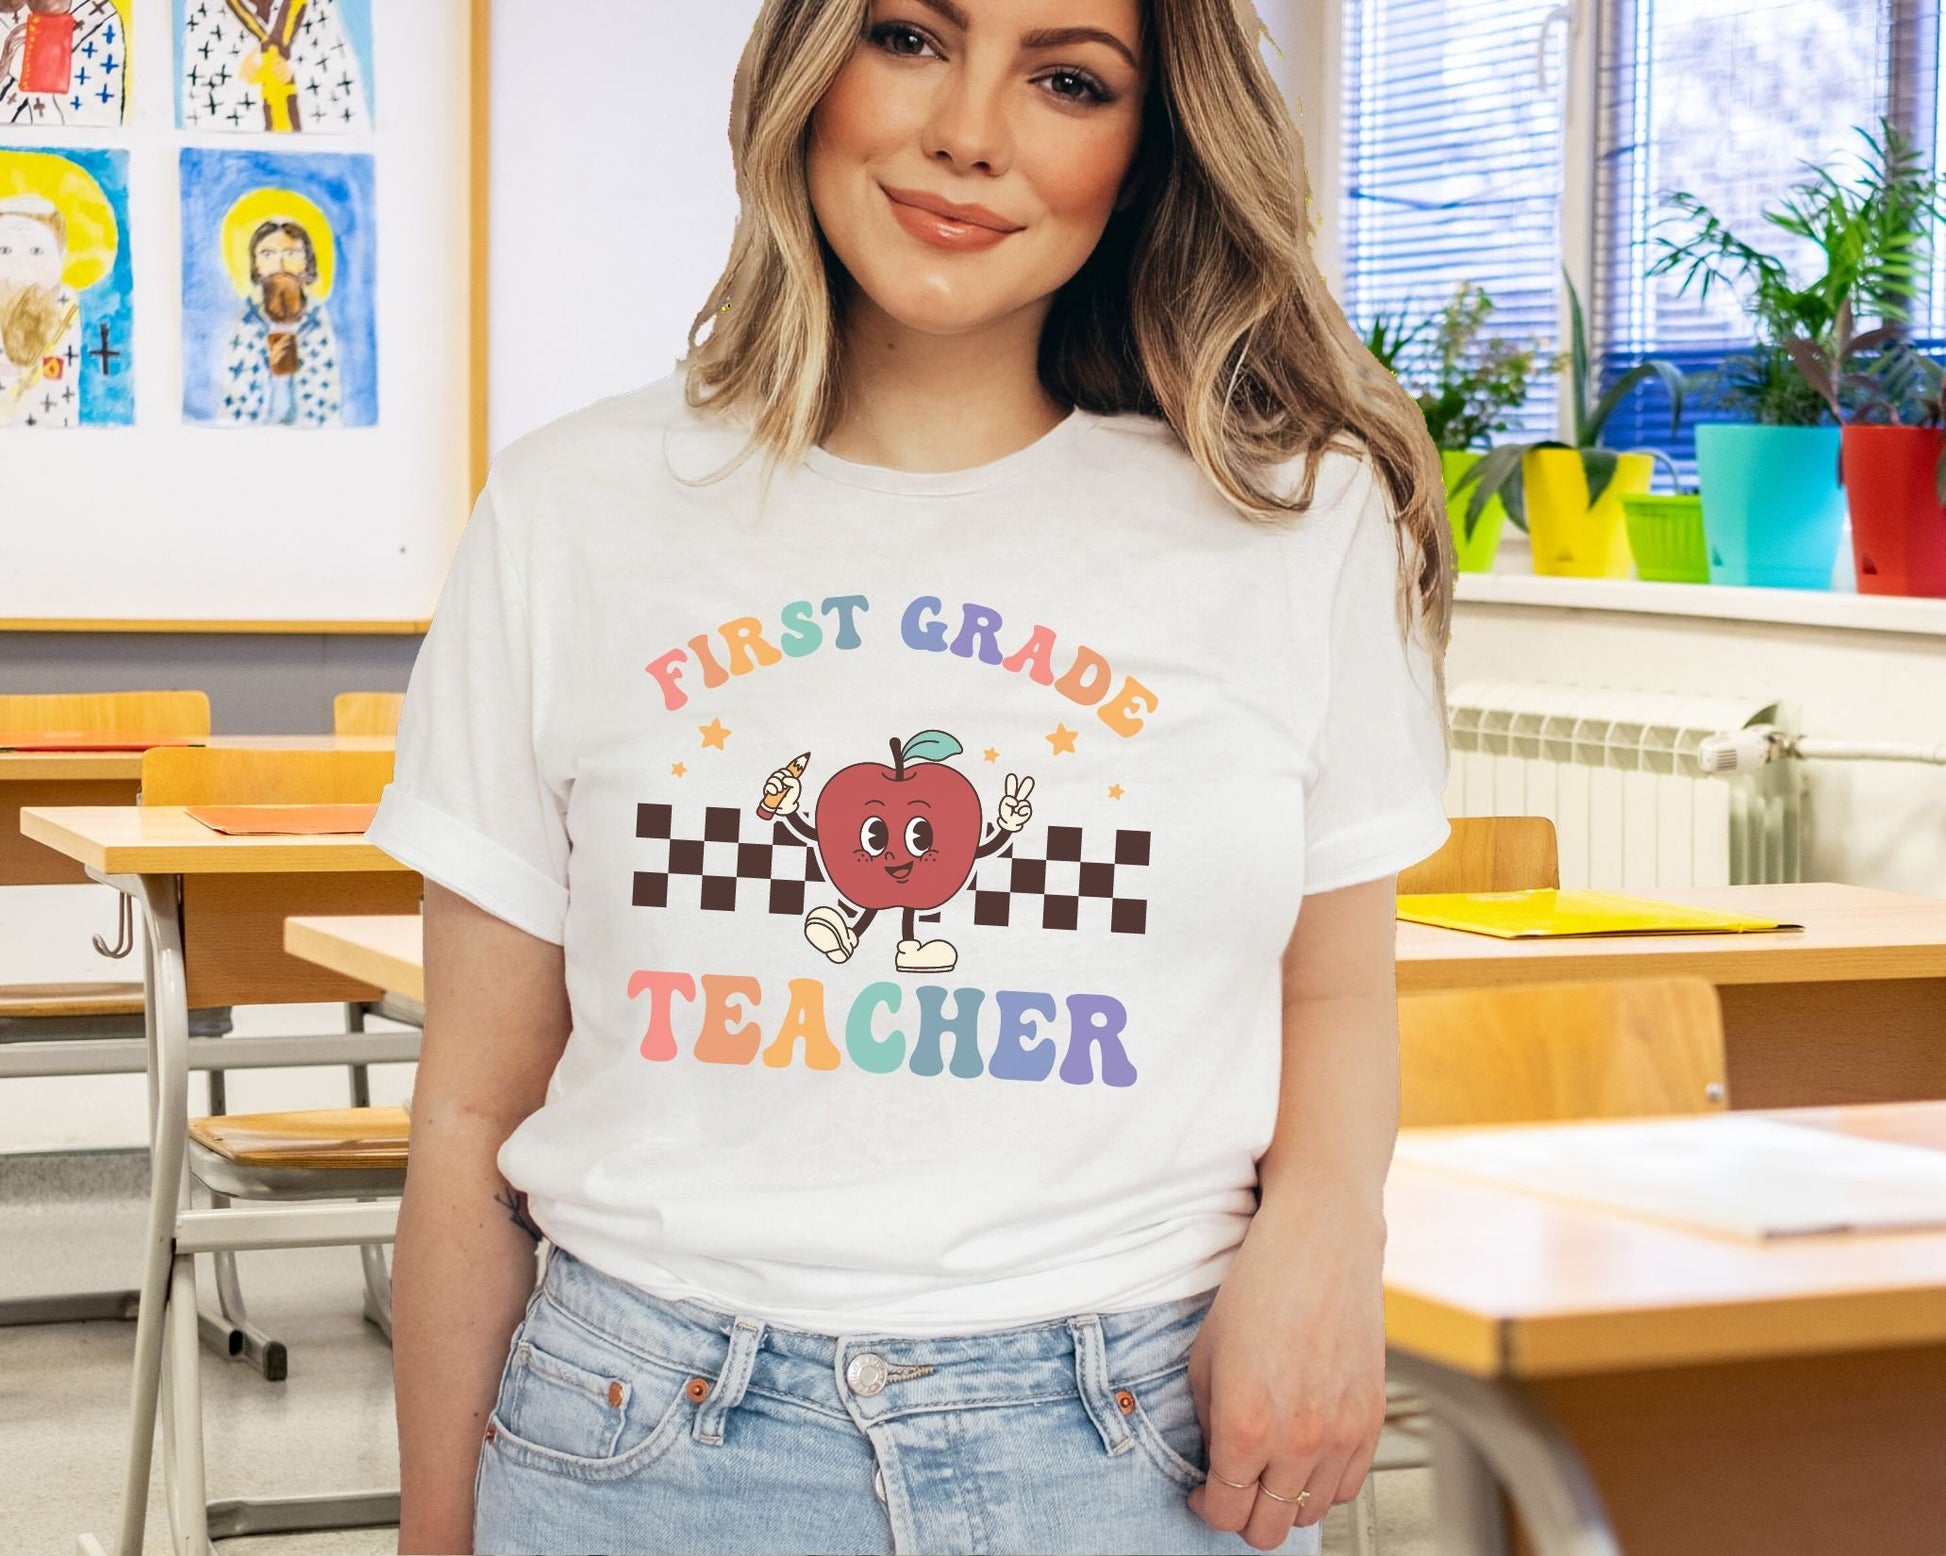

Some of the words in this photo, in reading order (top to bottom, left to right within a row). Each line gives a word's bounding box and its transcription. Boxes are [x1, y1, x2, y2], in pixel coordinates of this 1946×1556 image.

[645, 595, 869, 711] FIRST
[901, 596, 1158, 738] GRADE
[627, 970, 1137, 1087] TEACHER
